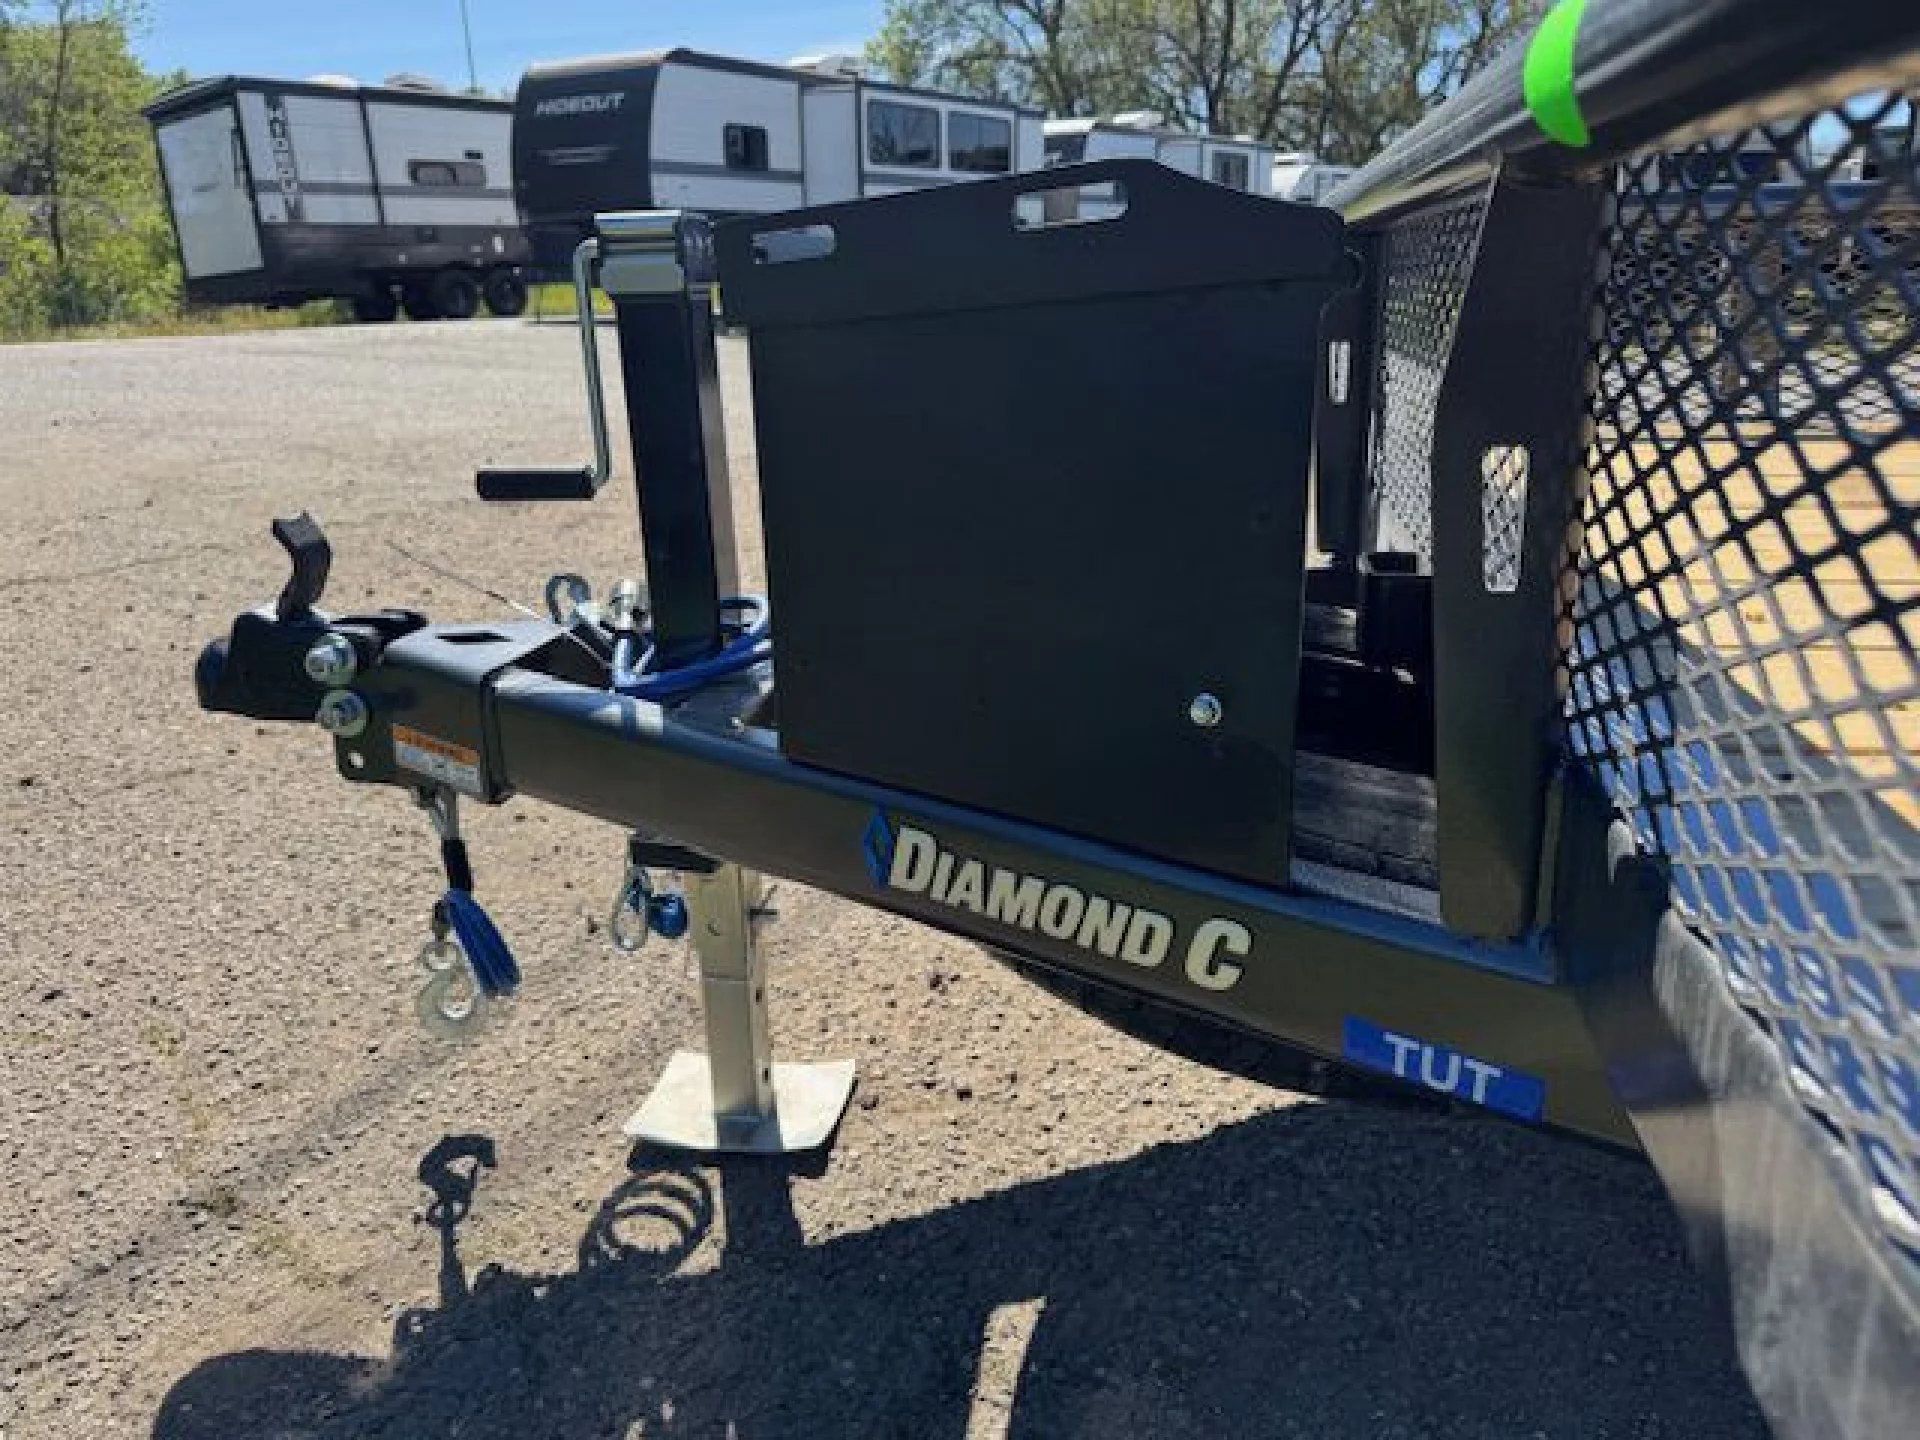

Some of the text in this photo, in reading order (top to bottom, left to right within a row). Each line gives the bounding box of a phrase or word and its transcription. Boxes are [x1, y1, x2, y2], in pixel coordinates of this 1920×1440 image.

[535, 92, 625, 116] HIDEOUT
[888, 827, 1250, 991] DIAMOND C
[1382, 1031, 1503, 1105] TUT
